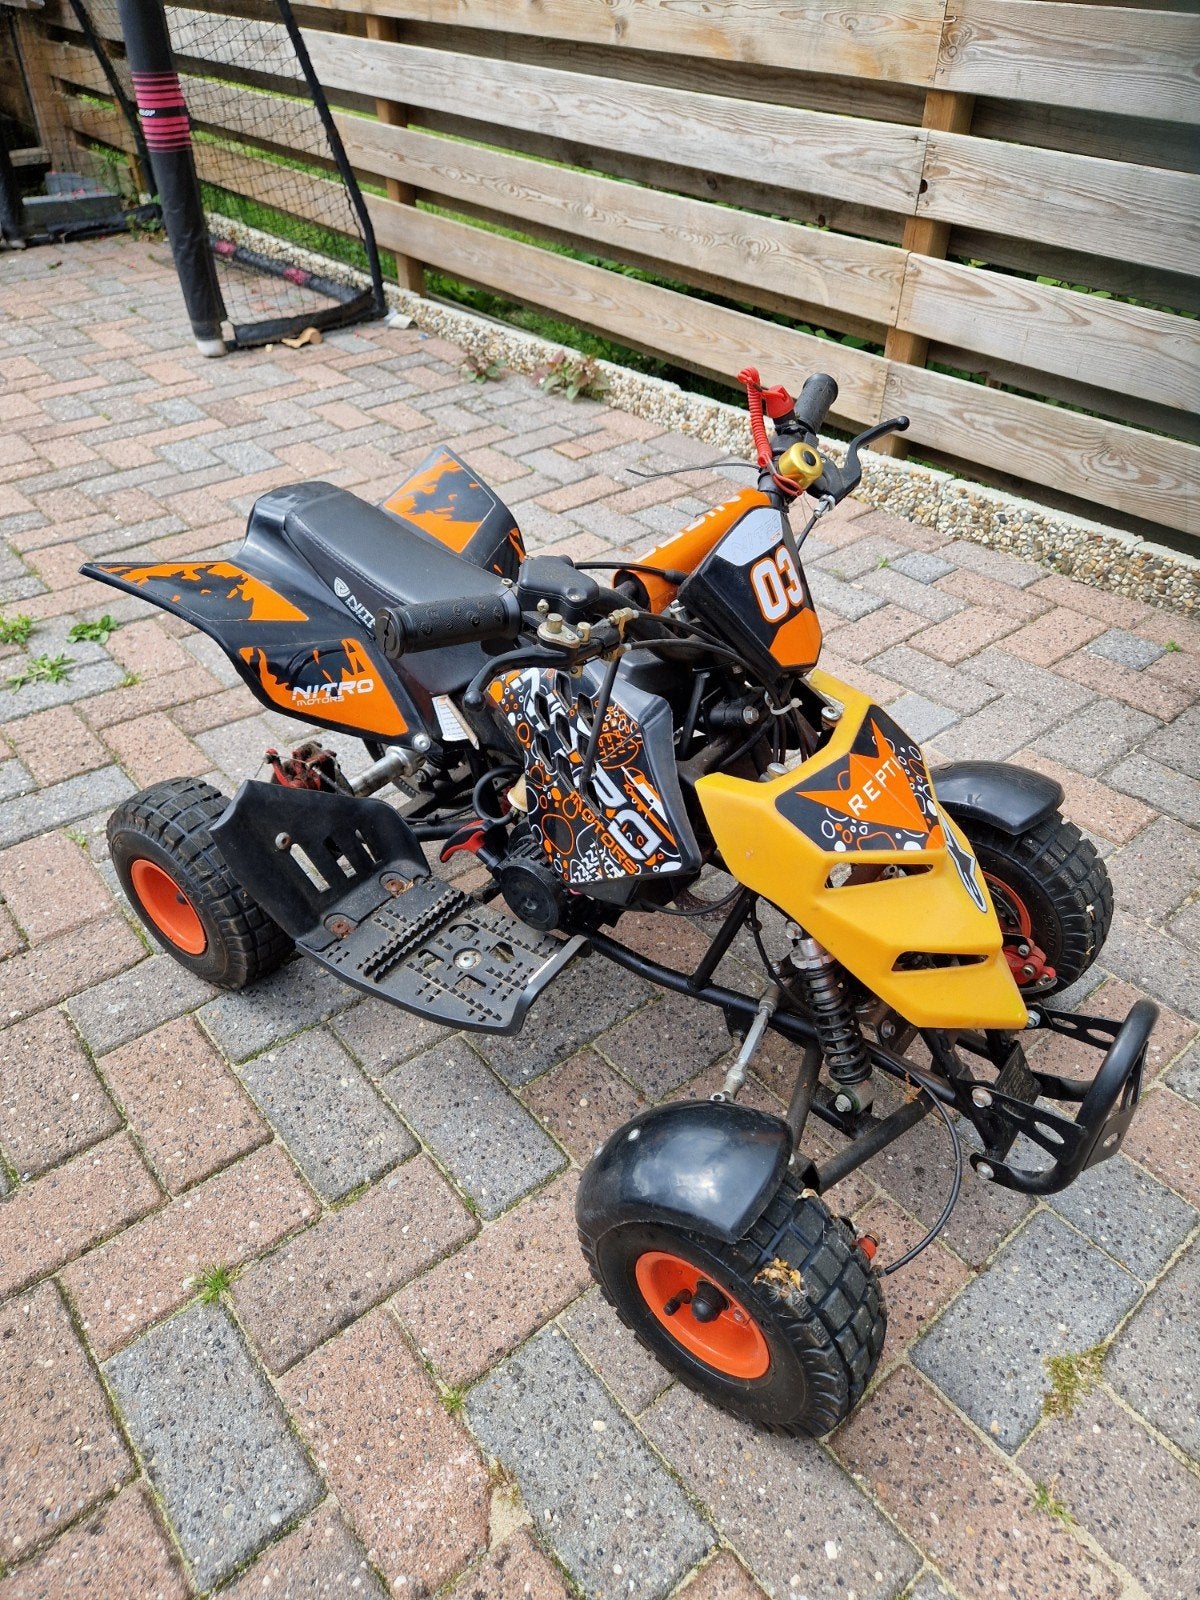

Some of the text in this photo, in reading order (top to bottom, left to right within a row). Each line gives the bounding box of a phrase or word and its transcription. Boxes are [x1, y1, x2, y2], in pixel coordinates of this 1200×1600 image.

[750, 545, 804, 624] 03
[291, 678, 374, 701] NITRO
[296, 695, 345, 707] MOTORS
[847, 756, 902, 817] REPTI
[569, 791, 638, 875] MOTORS
